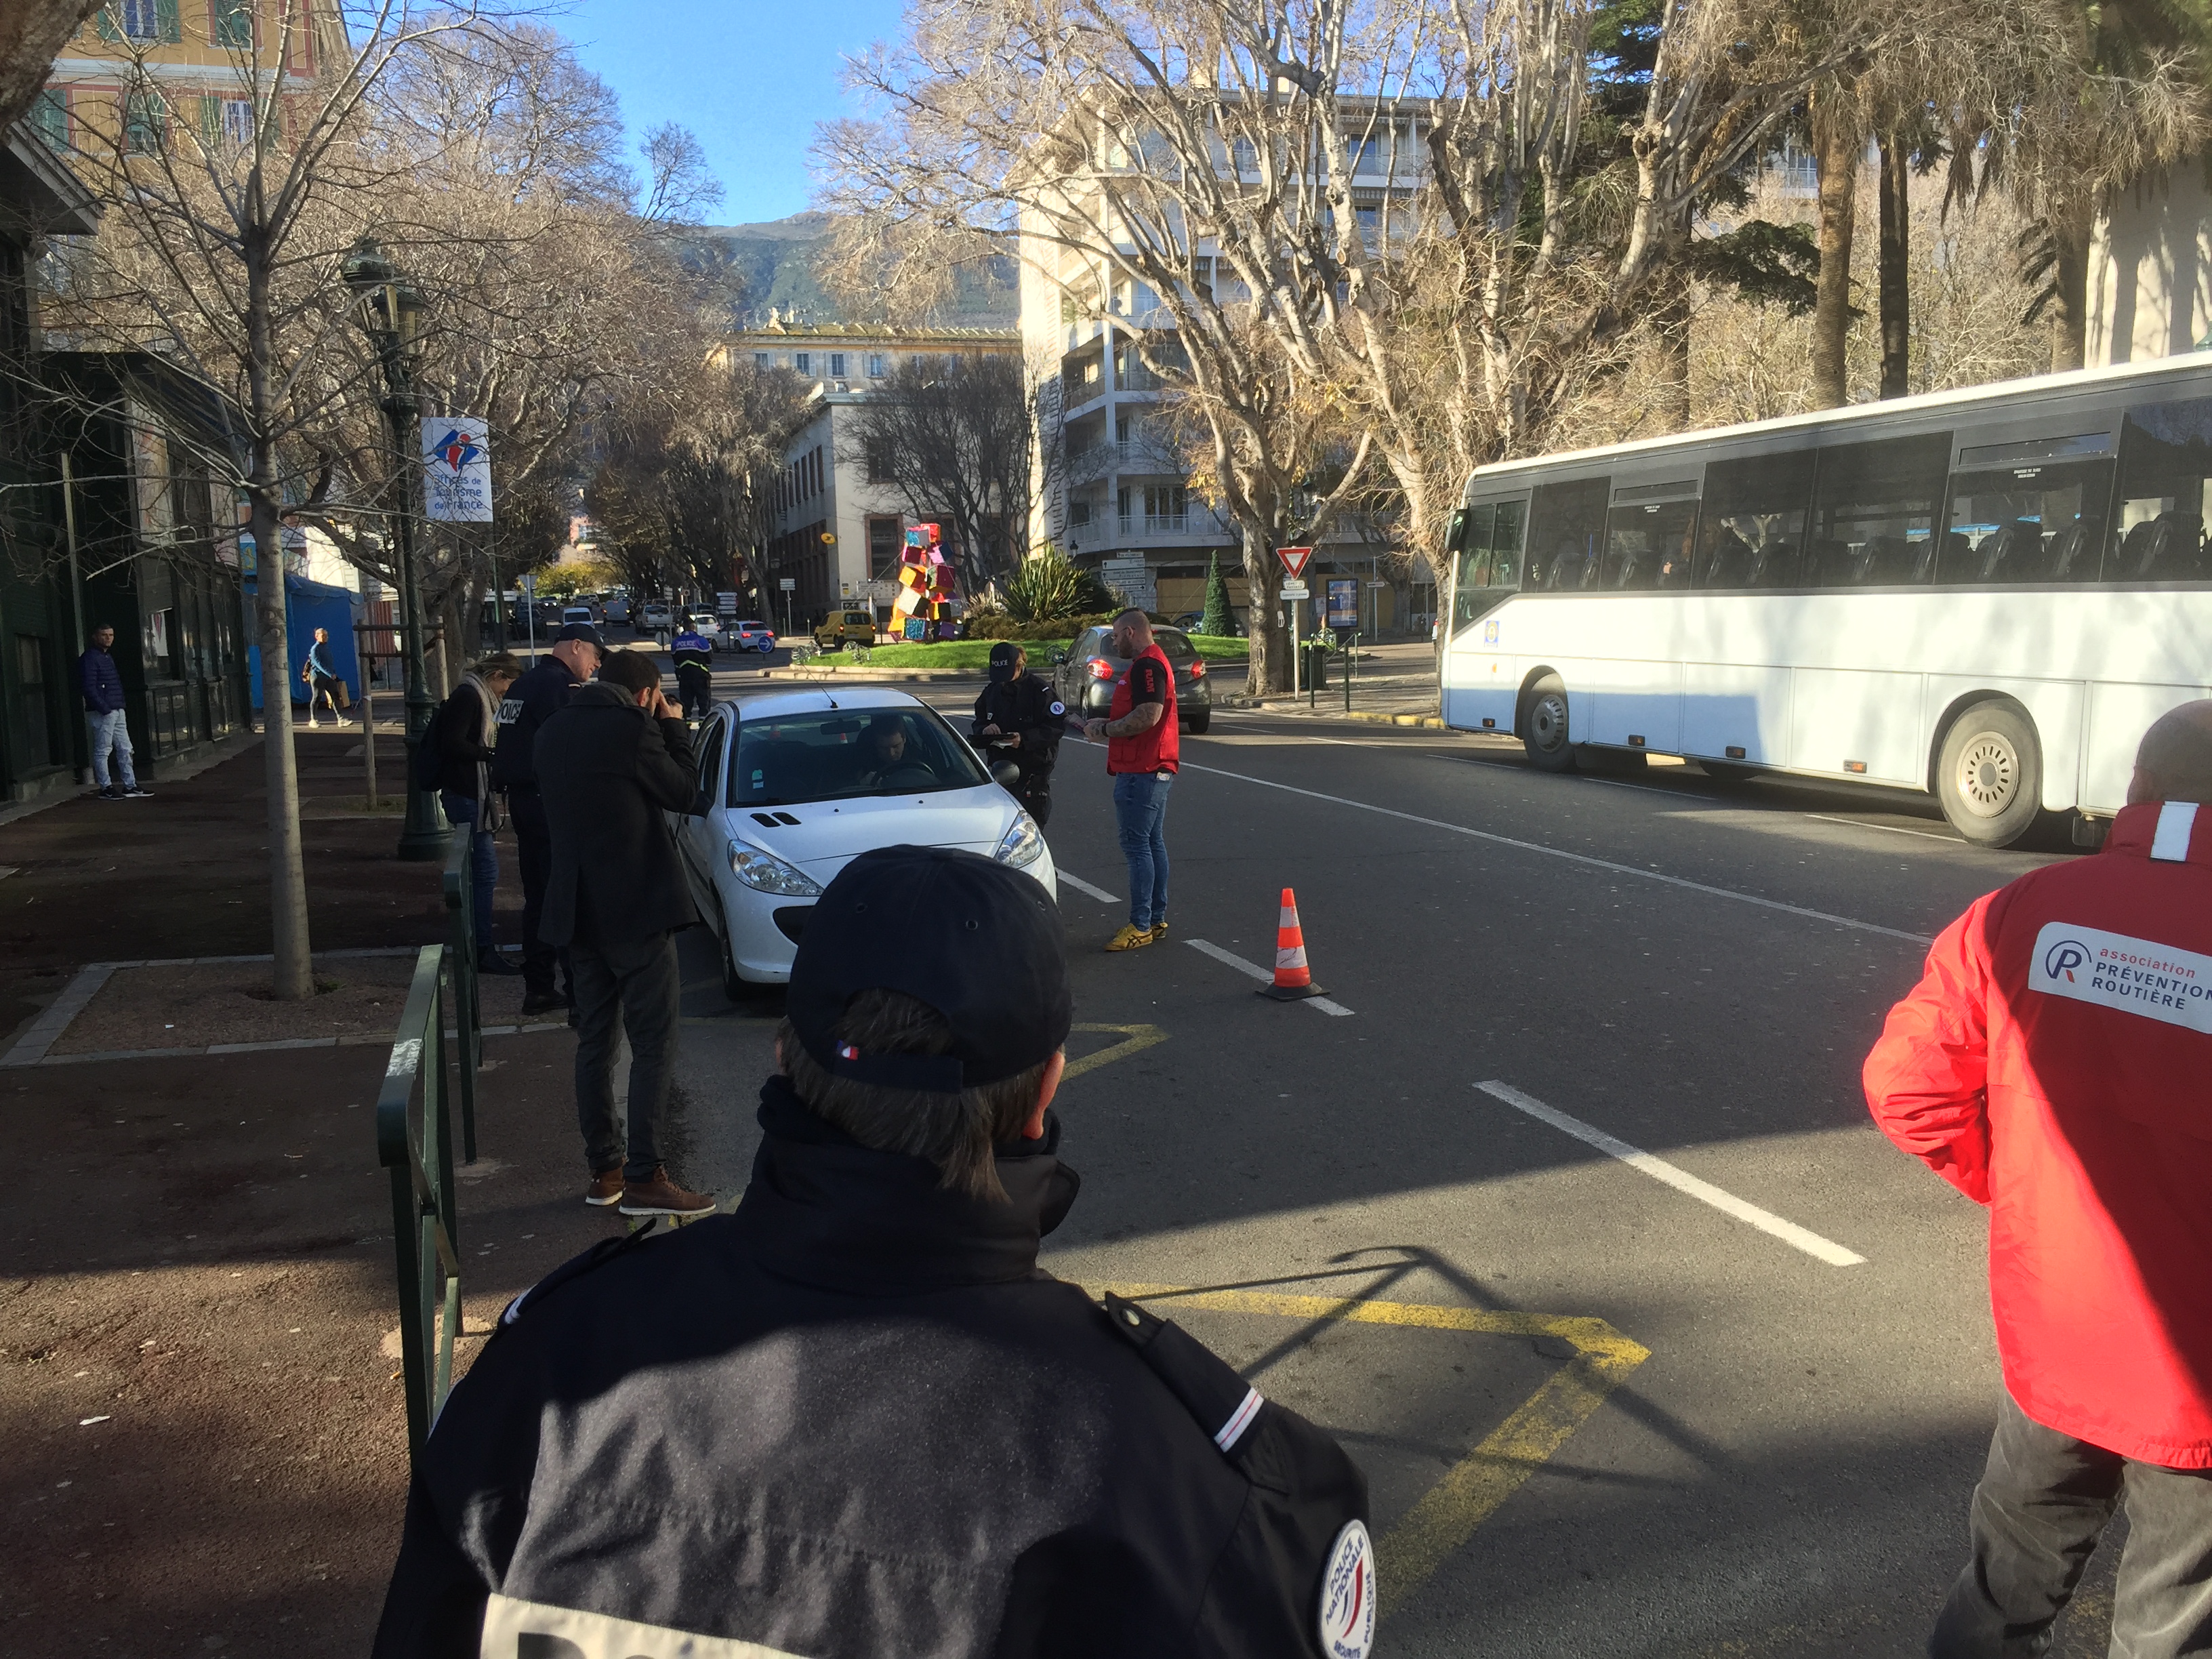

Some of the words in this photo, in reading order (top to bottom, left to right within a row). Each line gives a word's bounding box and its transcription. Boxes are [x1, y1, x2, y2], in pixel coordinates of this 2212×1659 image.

[2100, 947, 2196, 978] association
[2092, 977, 2186, 1010] ROUTIÈRE
[1326, 1534, 1364, 1626] NATIONALE
[1330, 1537, 1353, 1595] POLICE
